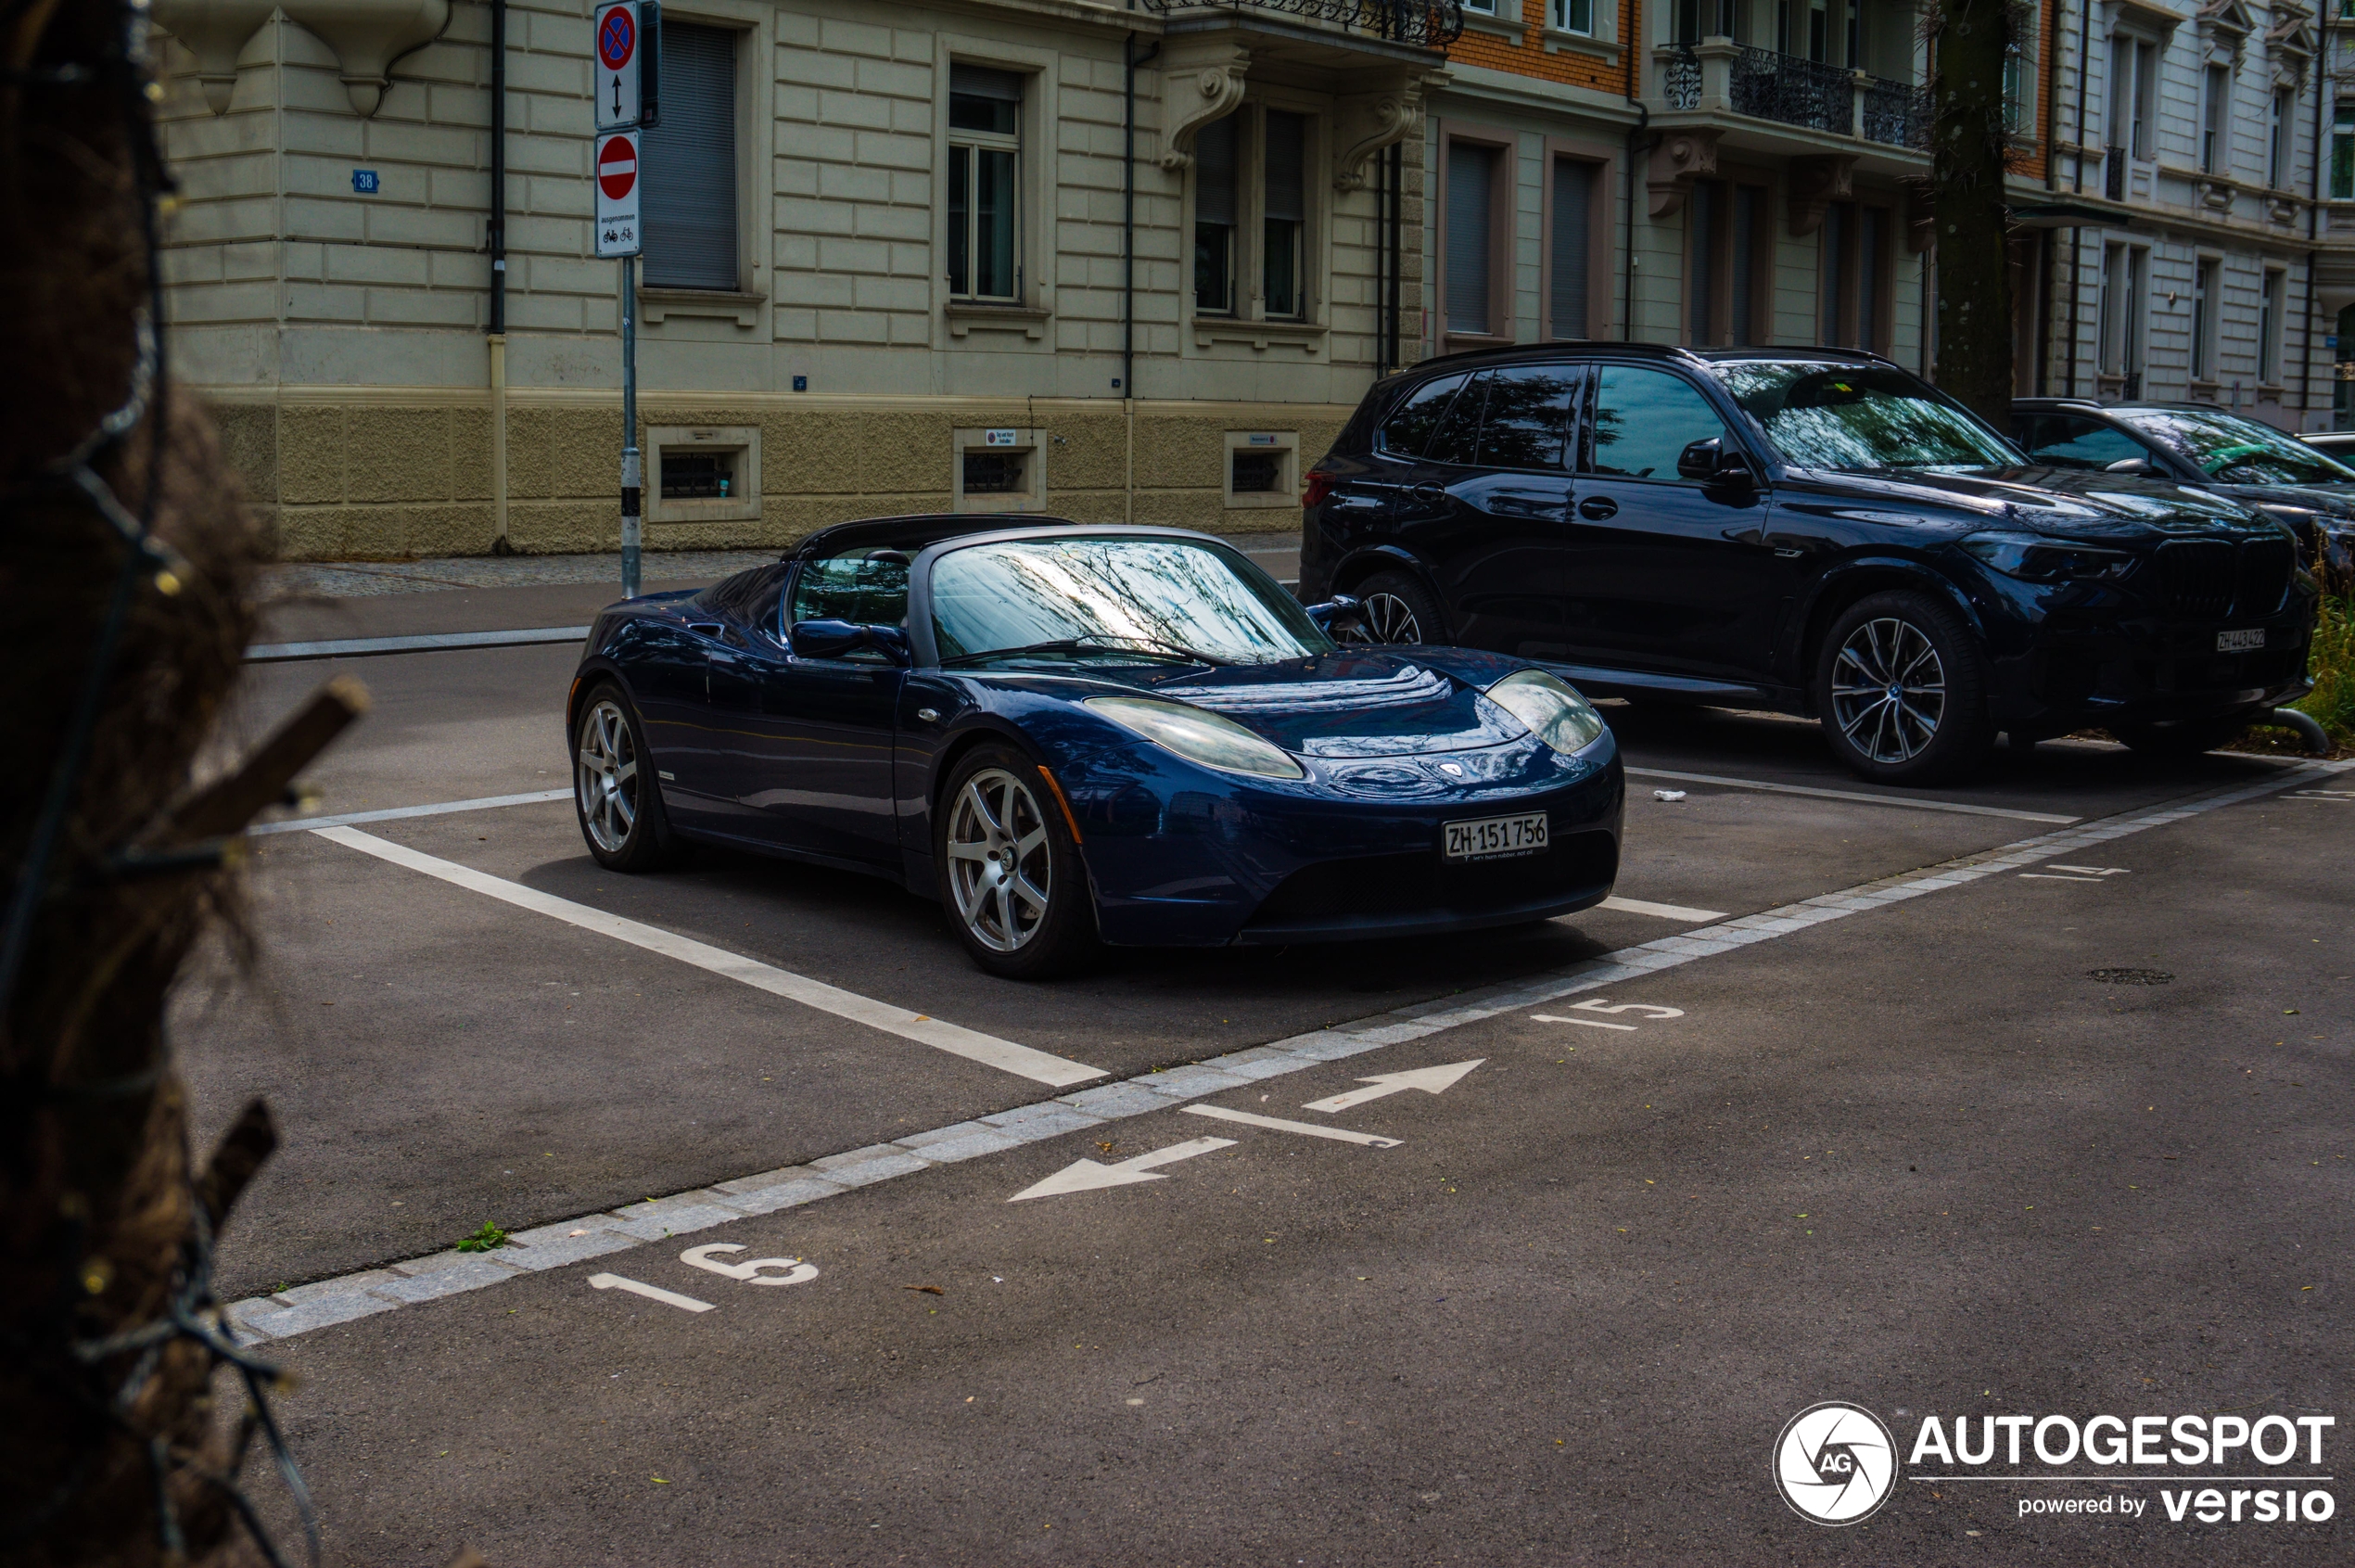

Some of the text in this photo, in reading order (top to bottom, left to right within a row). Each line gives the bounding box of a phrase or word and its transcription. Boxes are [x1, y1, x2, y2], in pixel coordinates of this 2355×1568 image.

[359, 173, 373, 189] 38
[601, 214, 636, 224] ausgenommen
[2018, 864, 2132, 882] 14
[1530, 998, 1685, 1031] 15
[588, 1243, 819, 1313] 16
